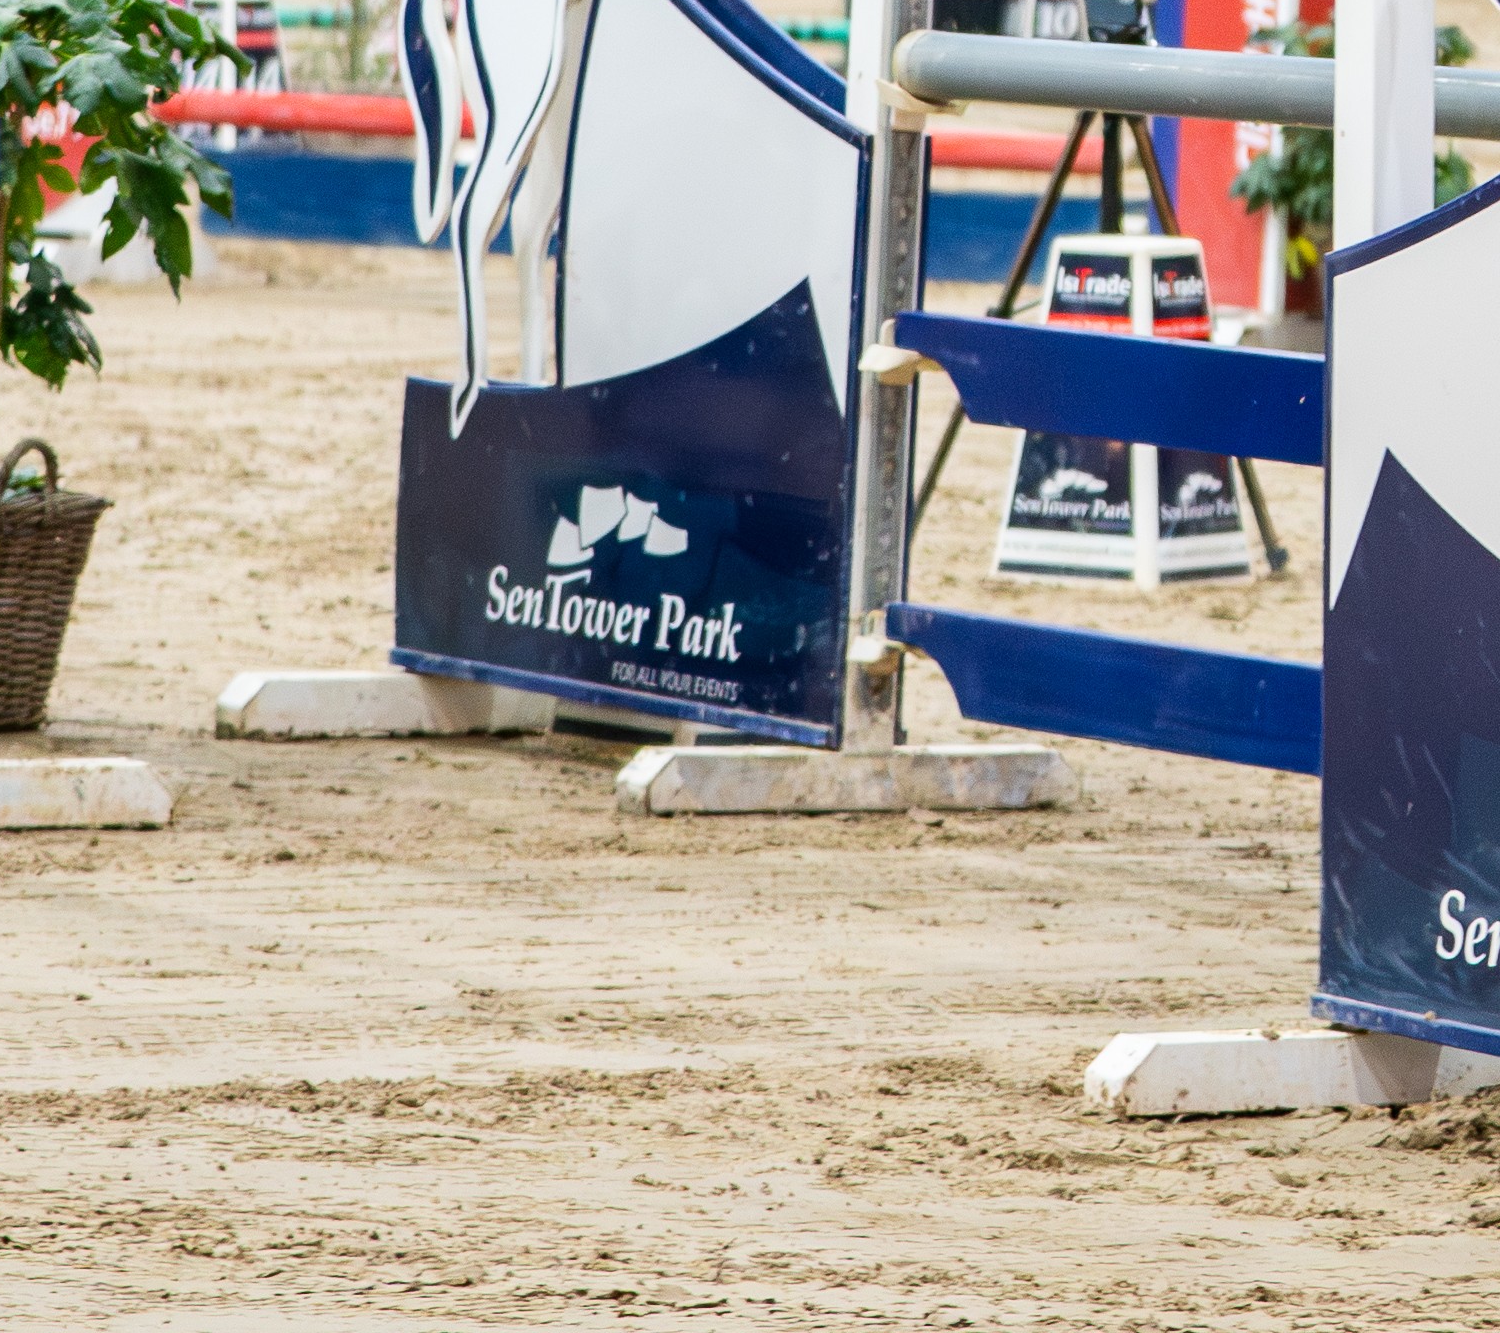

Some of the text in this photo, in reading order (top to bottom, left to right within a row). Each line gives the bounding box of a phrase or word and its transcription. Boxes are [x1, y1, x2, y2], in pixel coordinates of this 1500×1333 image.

[484, 563, 744, 665] SenTower Park
[611, 660, 740, 704] FOR ALL YOUR EVENTS
